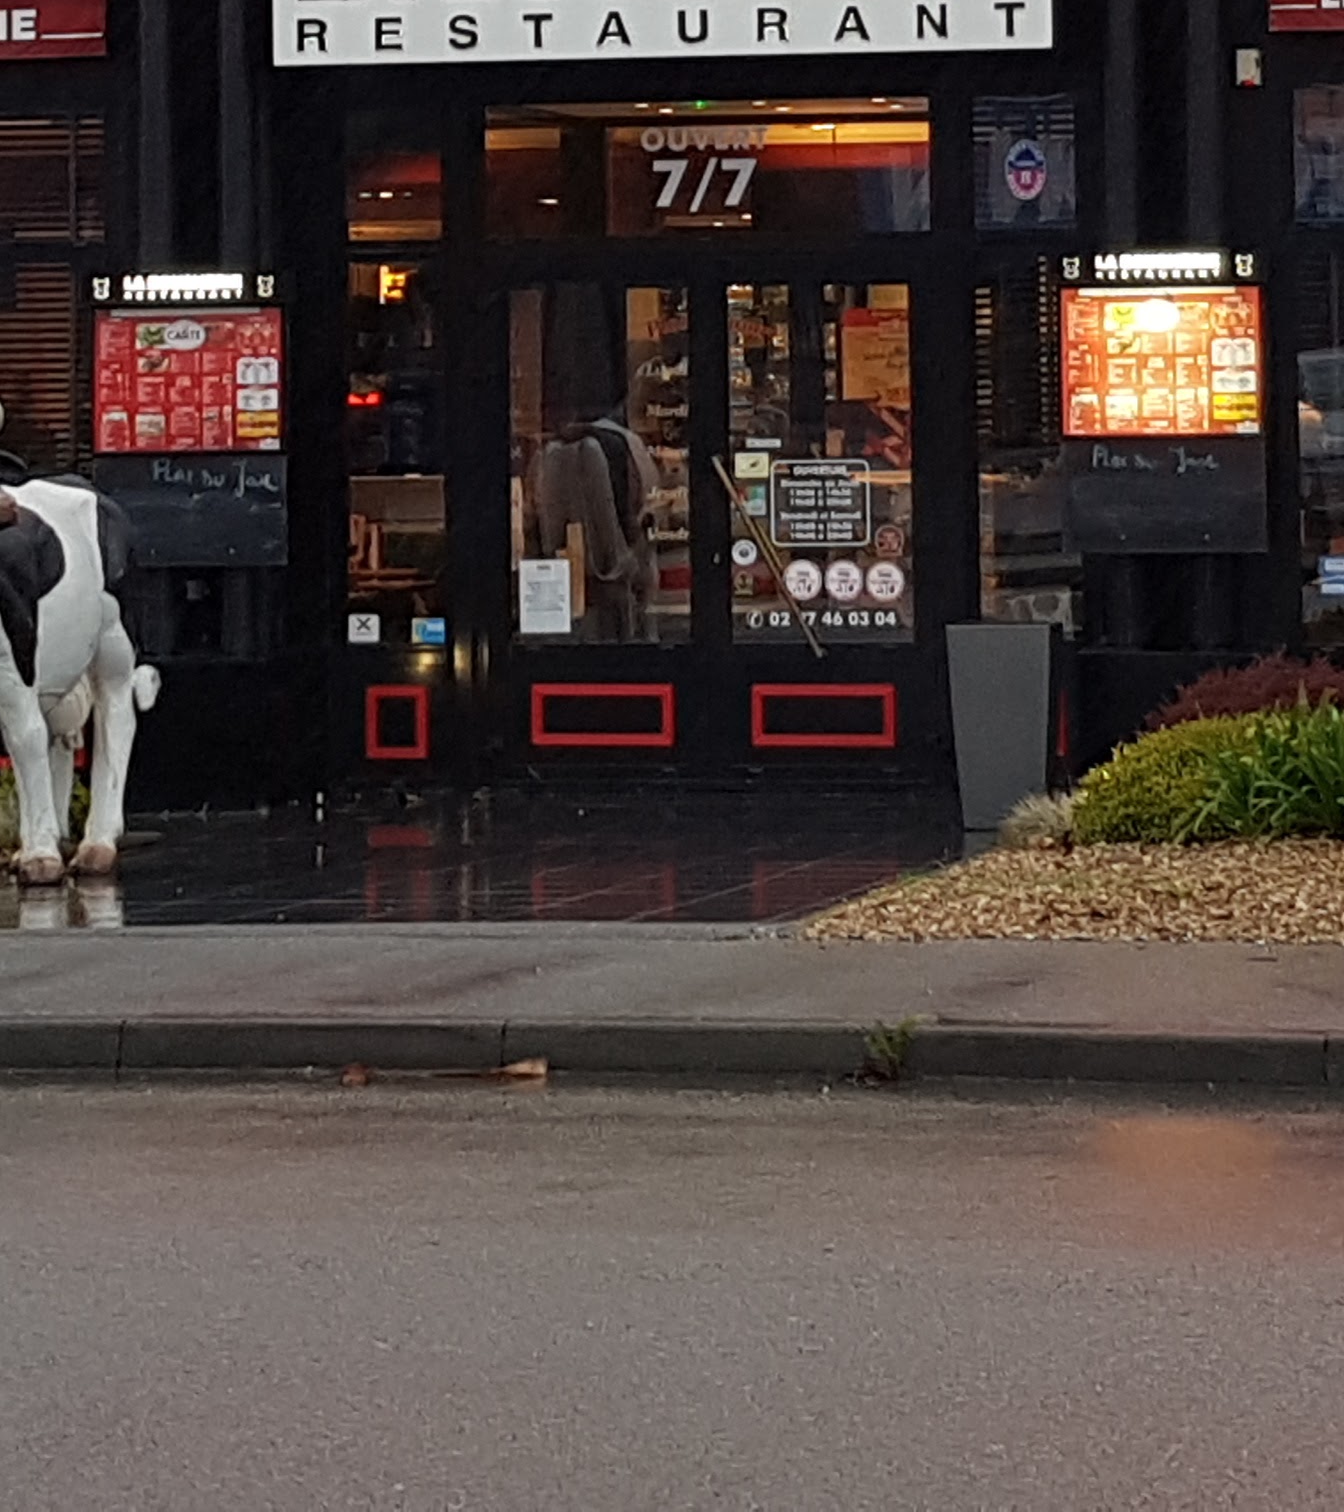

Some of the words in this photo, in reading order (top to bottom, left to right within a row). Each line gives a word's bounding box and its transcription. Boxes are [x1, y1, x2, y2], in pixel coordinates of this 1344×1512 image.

[297, 2, 1026, 52] RESTAURANT
[641, 127, 766, 152] OUVERT
[652, 157, 757, 213] 7/7
[769, 611, 791, 626] 02
[821, 611, 843, 626] 46
[848, 611, 869, 626] 03
[874, 611, 897, 626] 04
